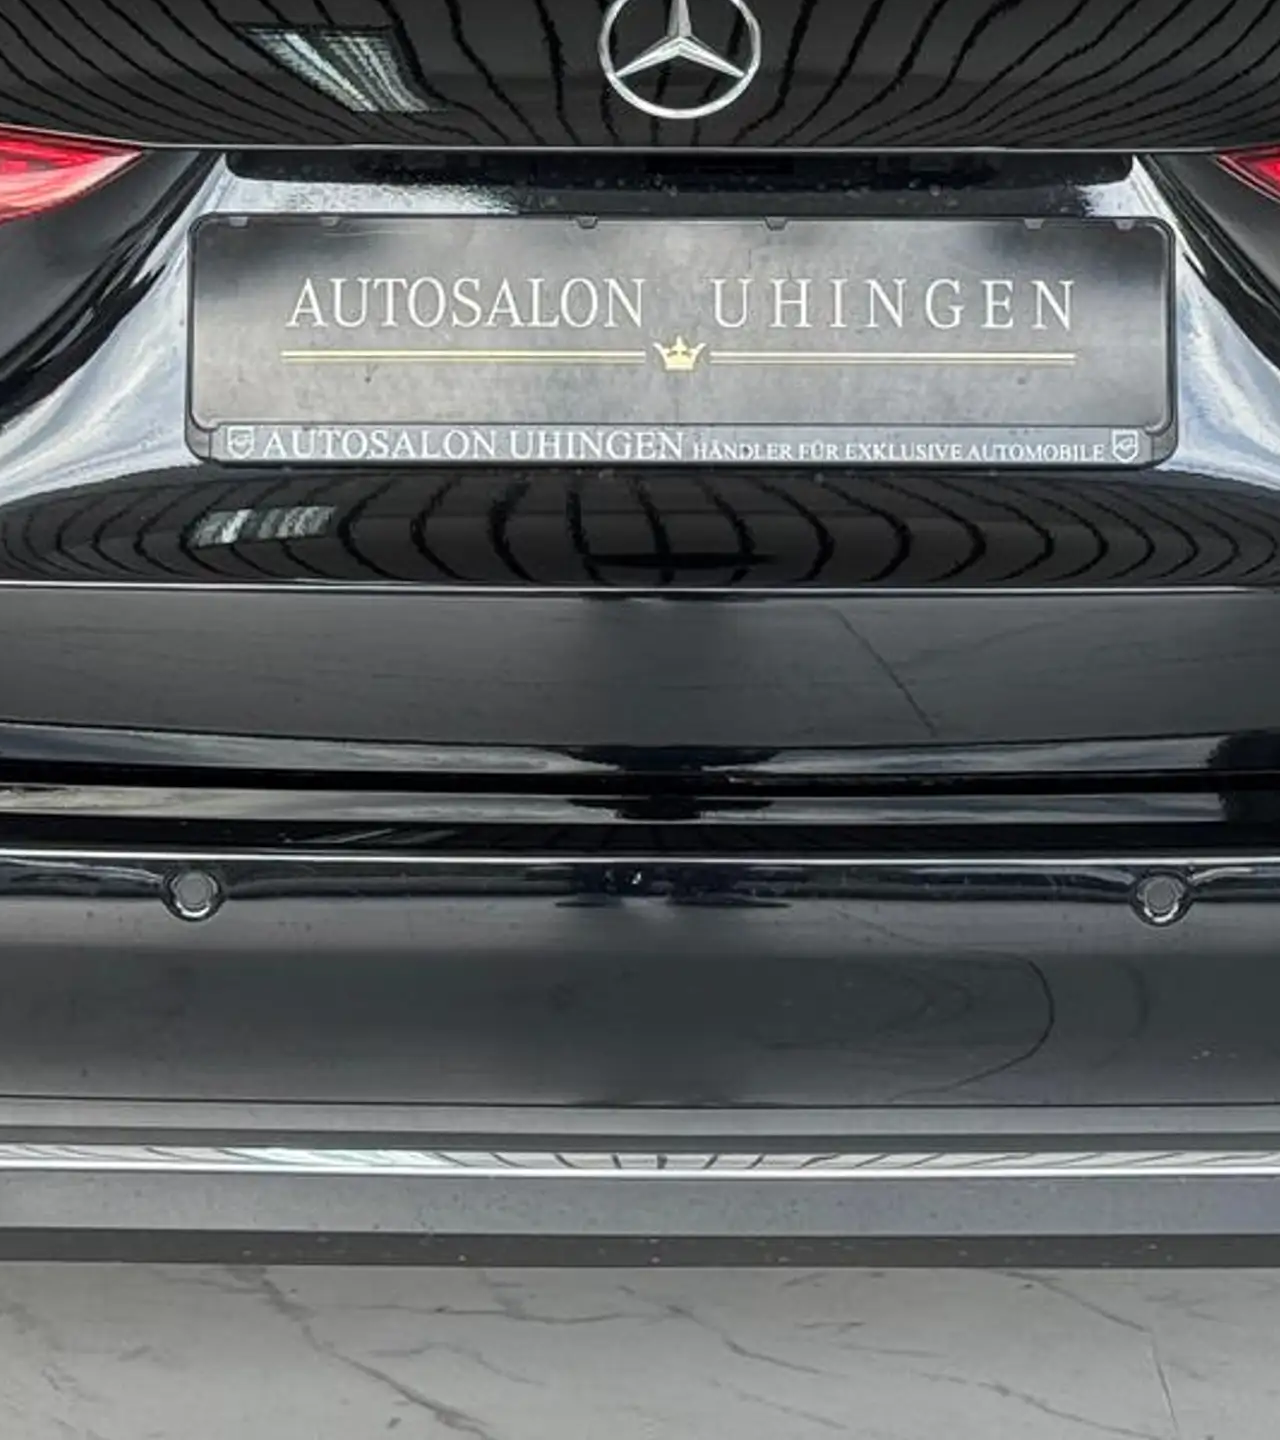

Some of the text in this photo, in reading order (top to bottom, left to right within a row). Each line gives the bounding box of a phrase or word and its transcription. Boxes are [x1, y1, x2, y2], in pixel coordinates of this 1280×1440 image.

[285, 277, 1074, 330] AUTOSALON UHINGEN
[262, 429, 497, 459] AUTOSALON
[509, 430, 684, 460] UHINGEN
[845, 443, 961, 460] EXKLUSIVE
[969, 443, 1104, 460] AUTOMOBILE
